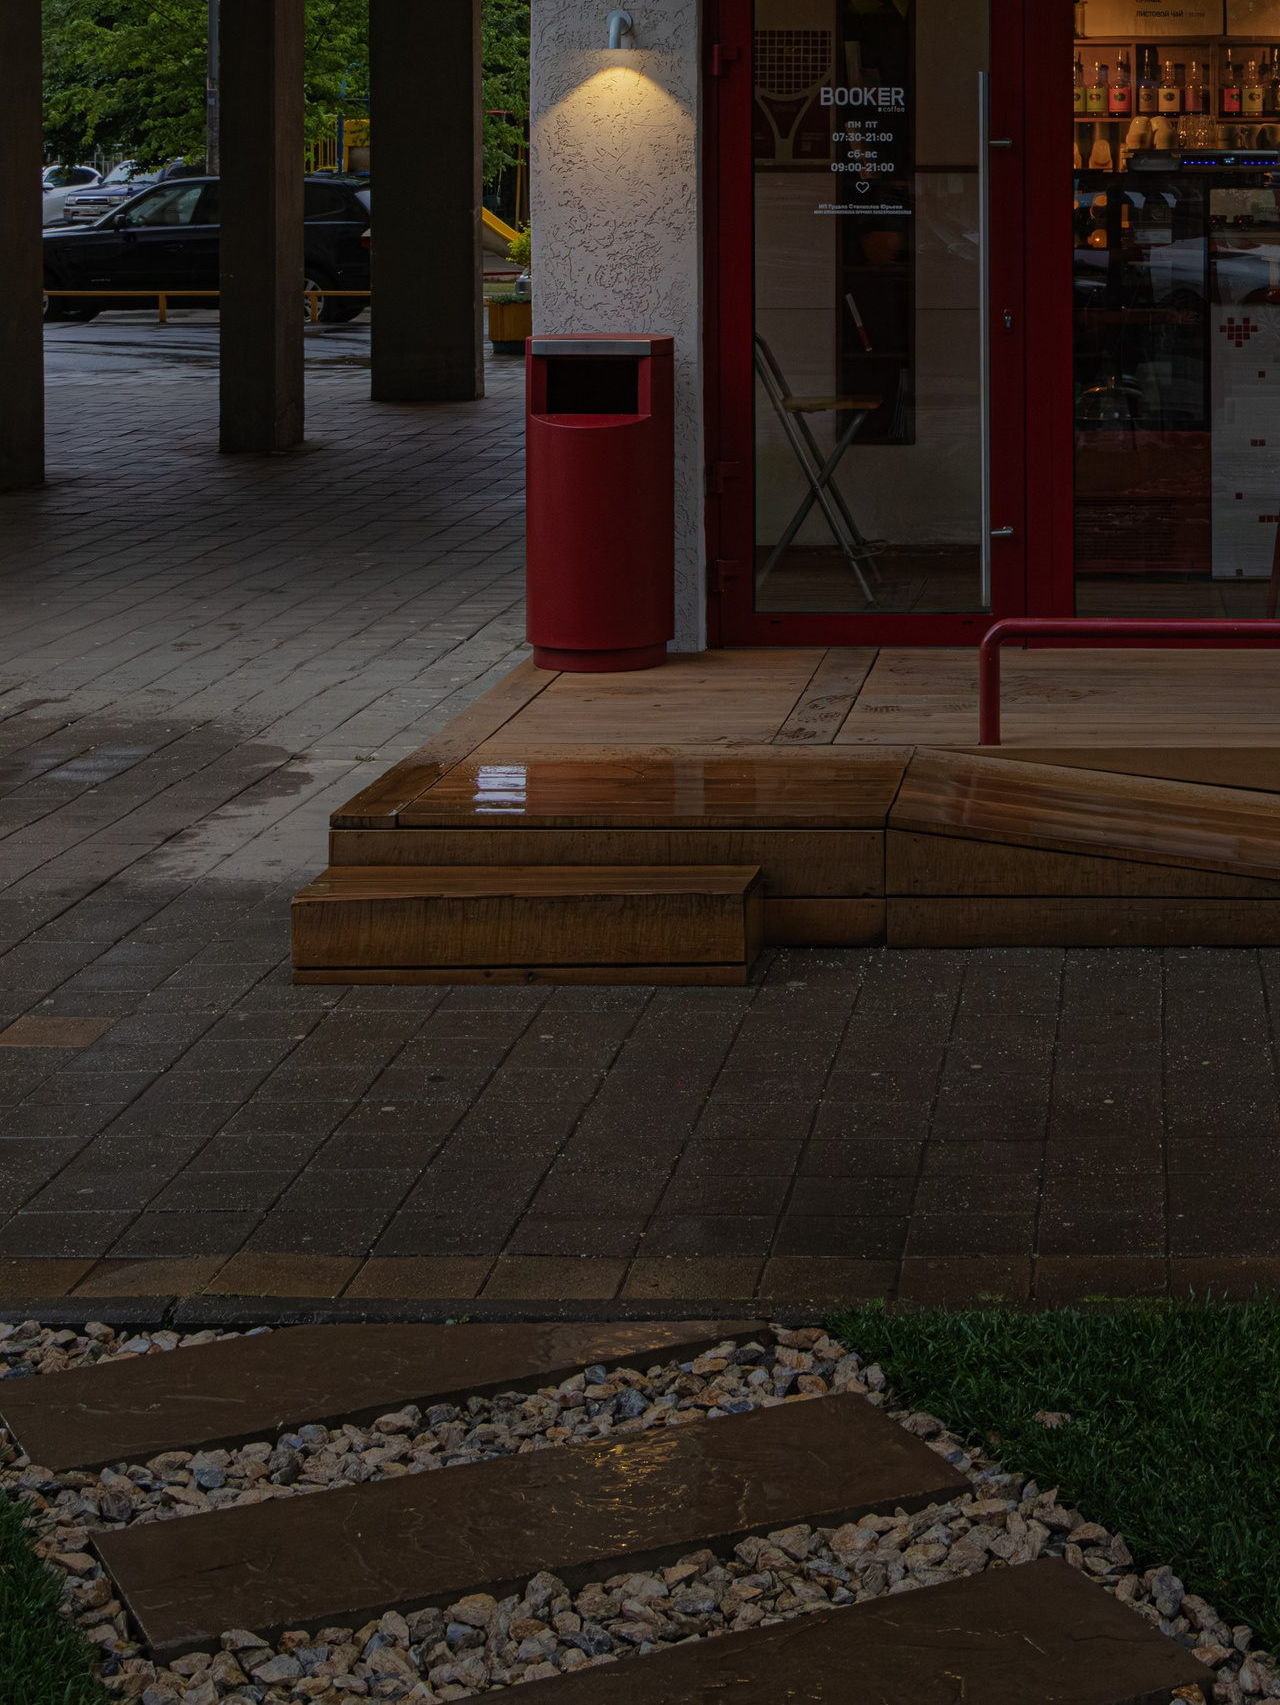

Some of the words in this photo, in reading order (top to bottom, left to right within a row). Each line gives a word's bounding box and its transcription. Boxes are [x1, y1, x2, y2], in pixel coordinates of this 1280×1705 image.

[1171, 9, 1184, 17] ЧАЙ
[820, 87, 905, 106] BOOKER
[882, 105, 906, 113] coffee
[832, 132, 894, 142] 07:30-21:00
[847, 149, 878, 159] сб-вс
[830, 162, 895, 173] 09:00-21:00
